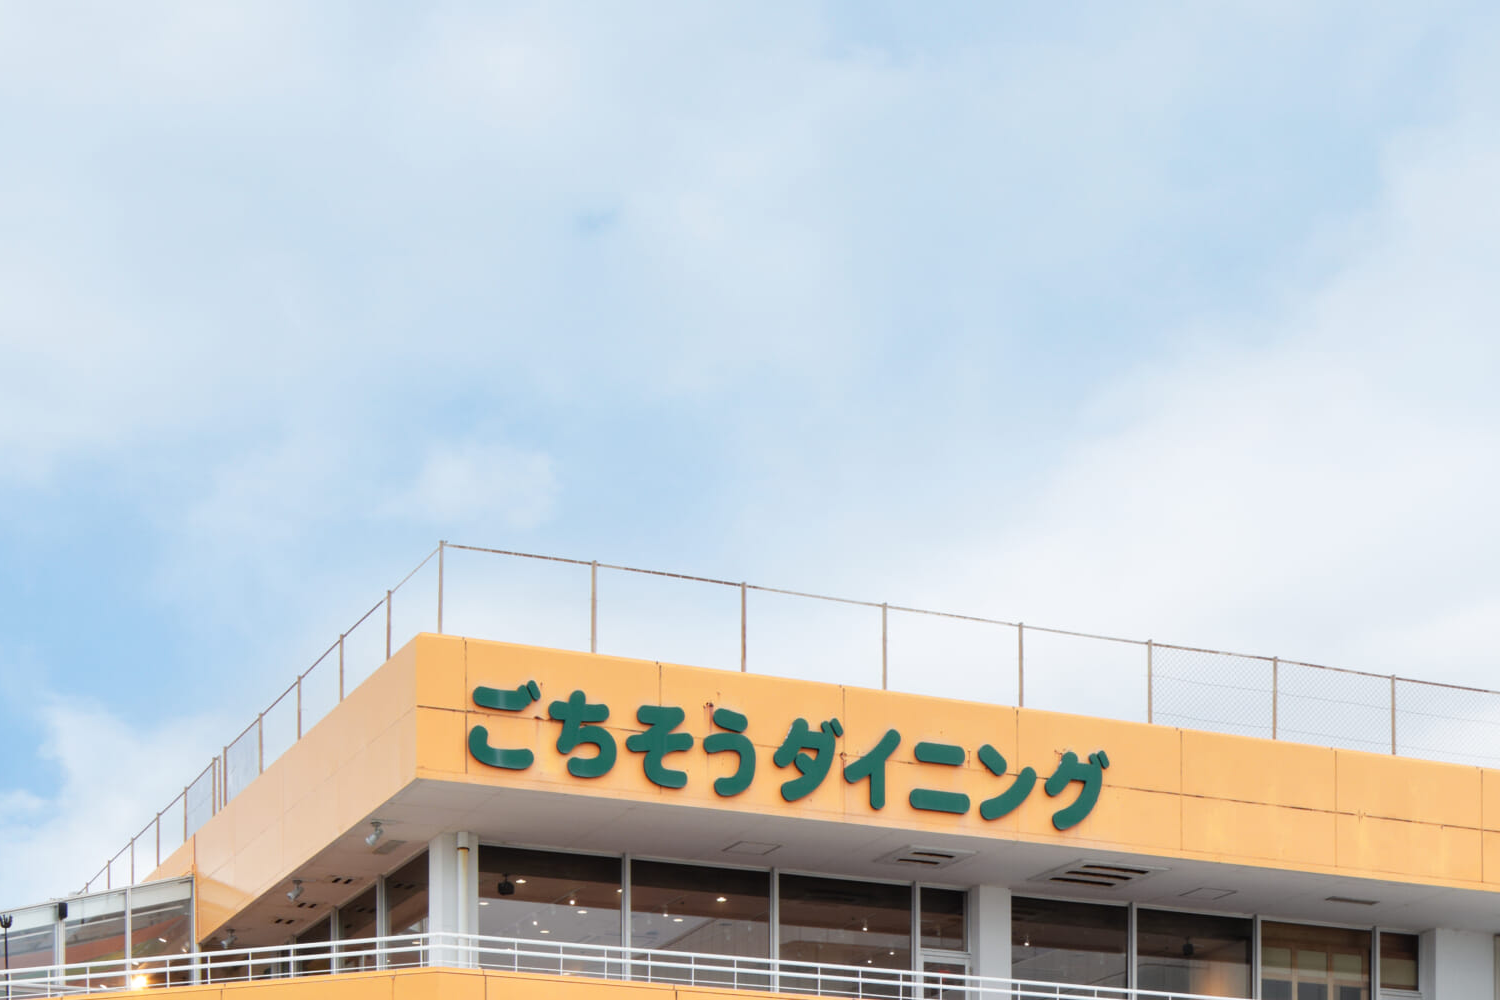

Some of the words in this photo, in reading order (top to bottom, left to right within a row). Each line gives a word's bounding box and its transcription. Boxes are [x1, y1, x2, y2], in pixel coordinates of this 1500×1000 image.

[468, 680, 1110, 832] ごちそうダイニング
